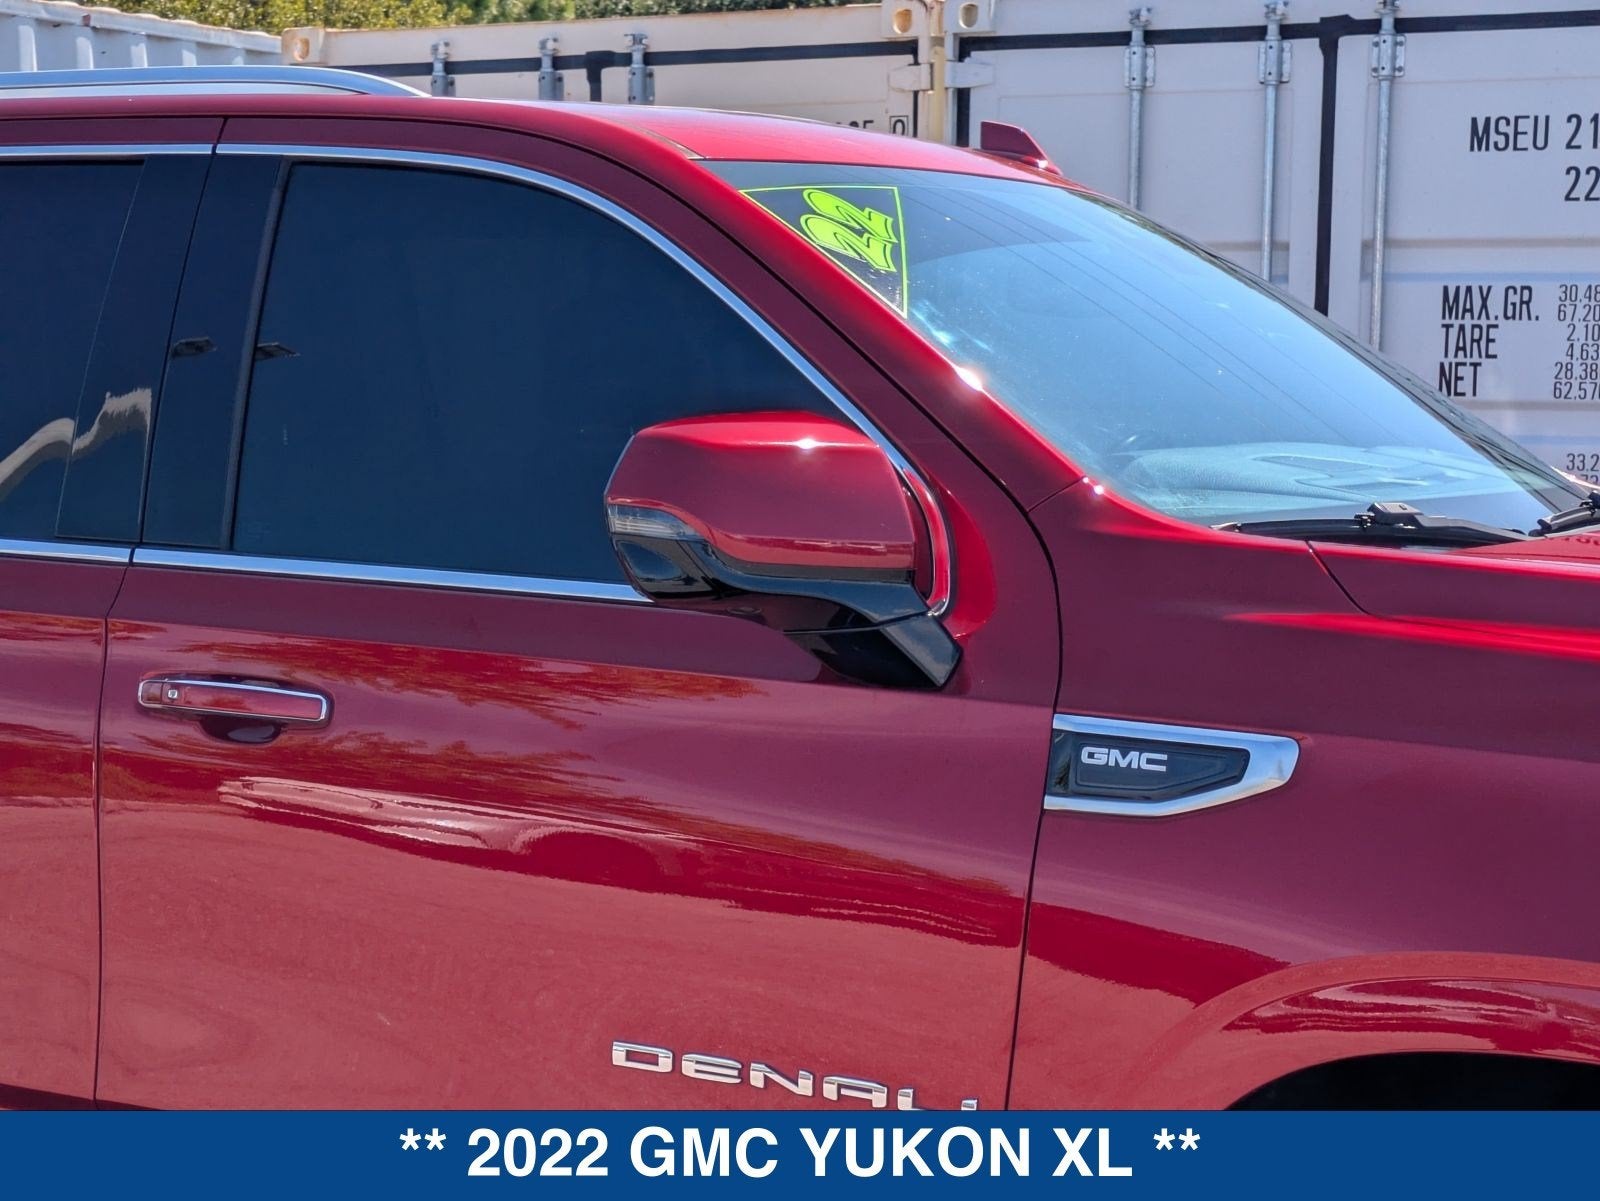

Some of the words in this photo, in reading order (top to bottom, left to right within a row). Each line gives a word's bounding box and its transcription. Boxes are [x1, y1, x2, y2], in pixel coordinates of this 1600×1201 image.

[1469, 115, 1550, 152] MSEU
[1565, 113, 1600, 149] 21
[1564, 166, 1600, 201] 22
[800, 188, 898, 272] 22
[1441, 285, 1540, 321] MAX.GR.
[1441, 323, 1499, 359] TARE
[1438, 361, 1482, 397] NET
[1553, 381, 1600, 400] 62.57
[1081, 746, 1168, 773] GMC
